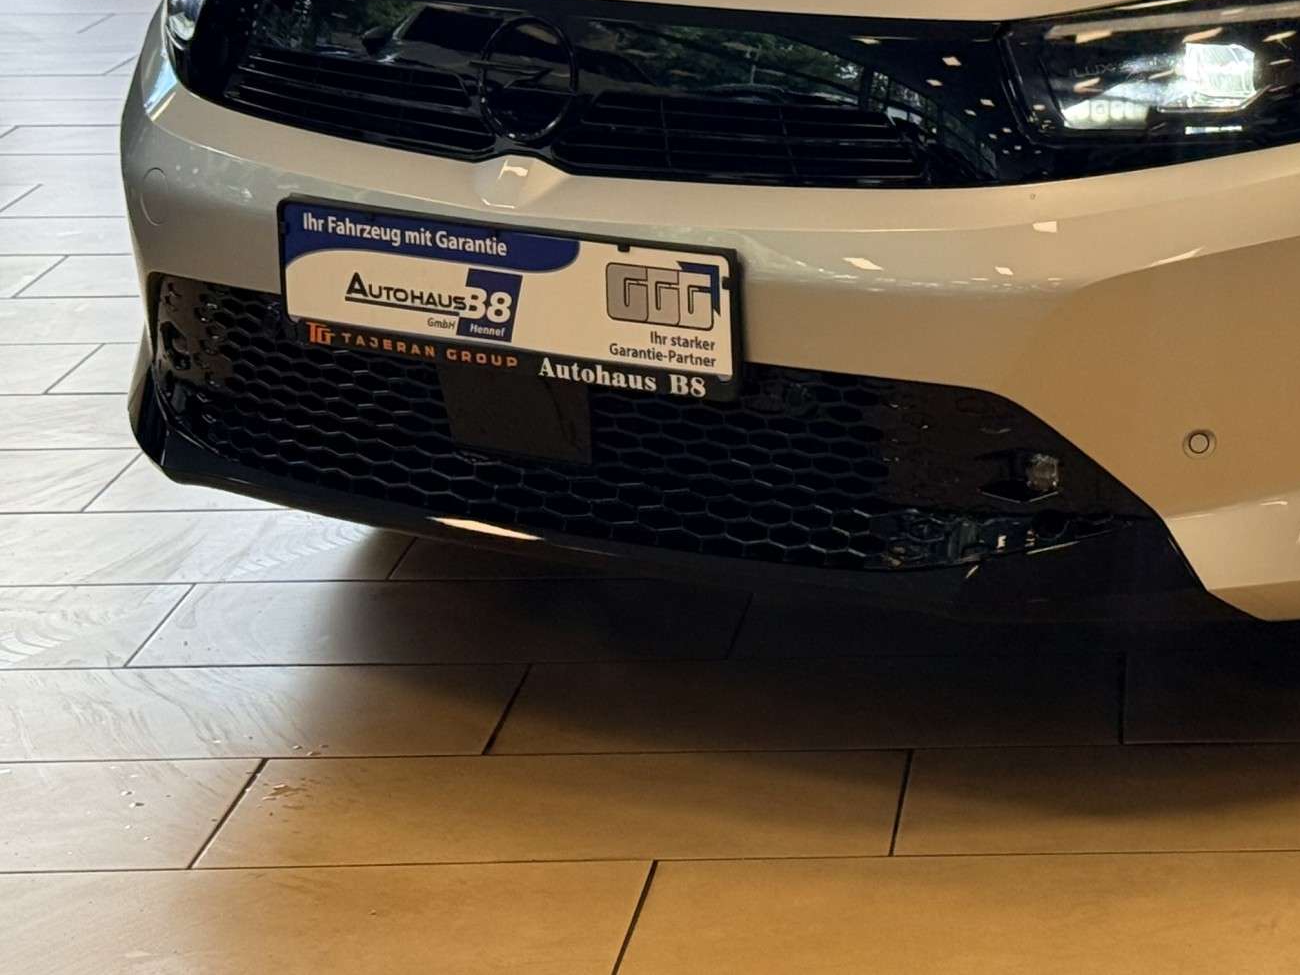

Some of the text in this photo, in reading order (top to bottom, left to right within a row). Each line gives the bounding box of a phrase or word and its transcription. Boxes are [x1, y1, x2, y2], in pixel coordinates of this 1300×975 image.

[303, 212, 507, 257] Ihr Fahrzeug mit Garantie
[427, 317, 456, 330] GmbH
[470, 322, 506, 338] Hennef
[342, 332, 436, 358] TAJERAN
[446, 348, 518, 368] GROUP
[649, 331, 716, 351] Ihr starker
[609, 342, 717, 367] Garantie-Partner
[538, 357, 707, 399] Autohaus B8
